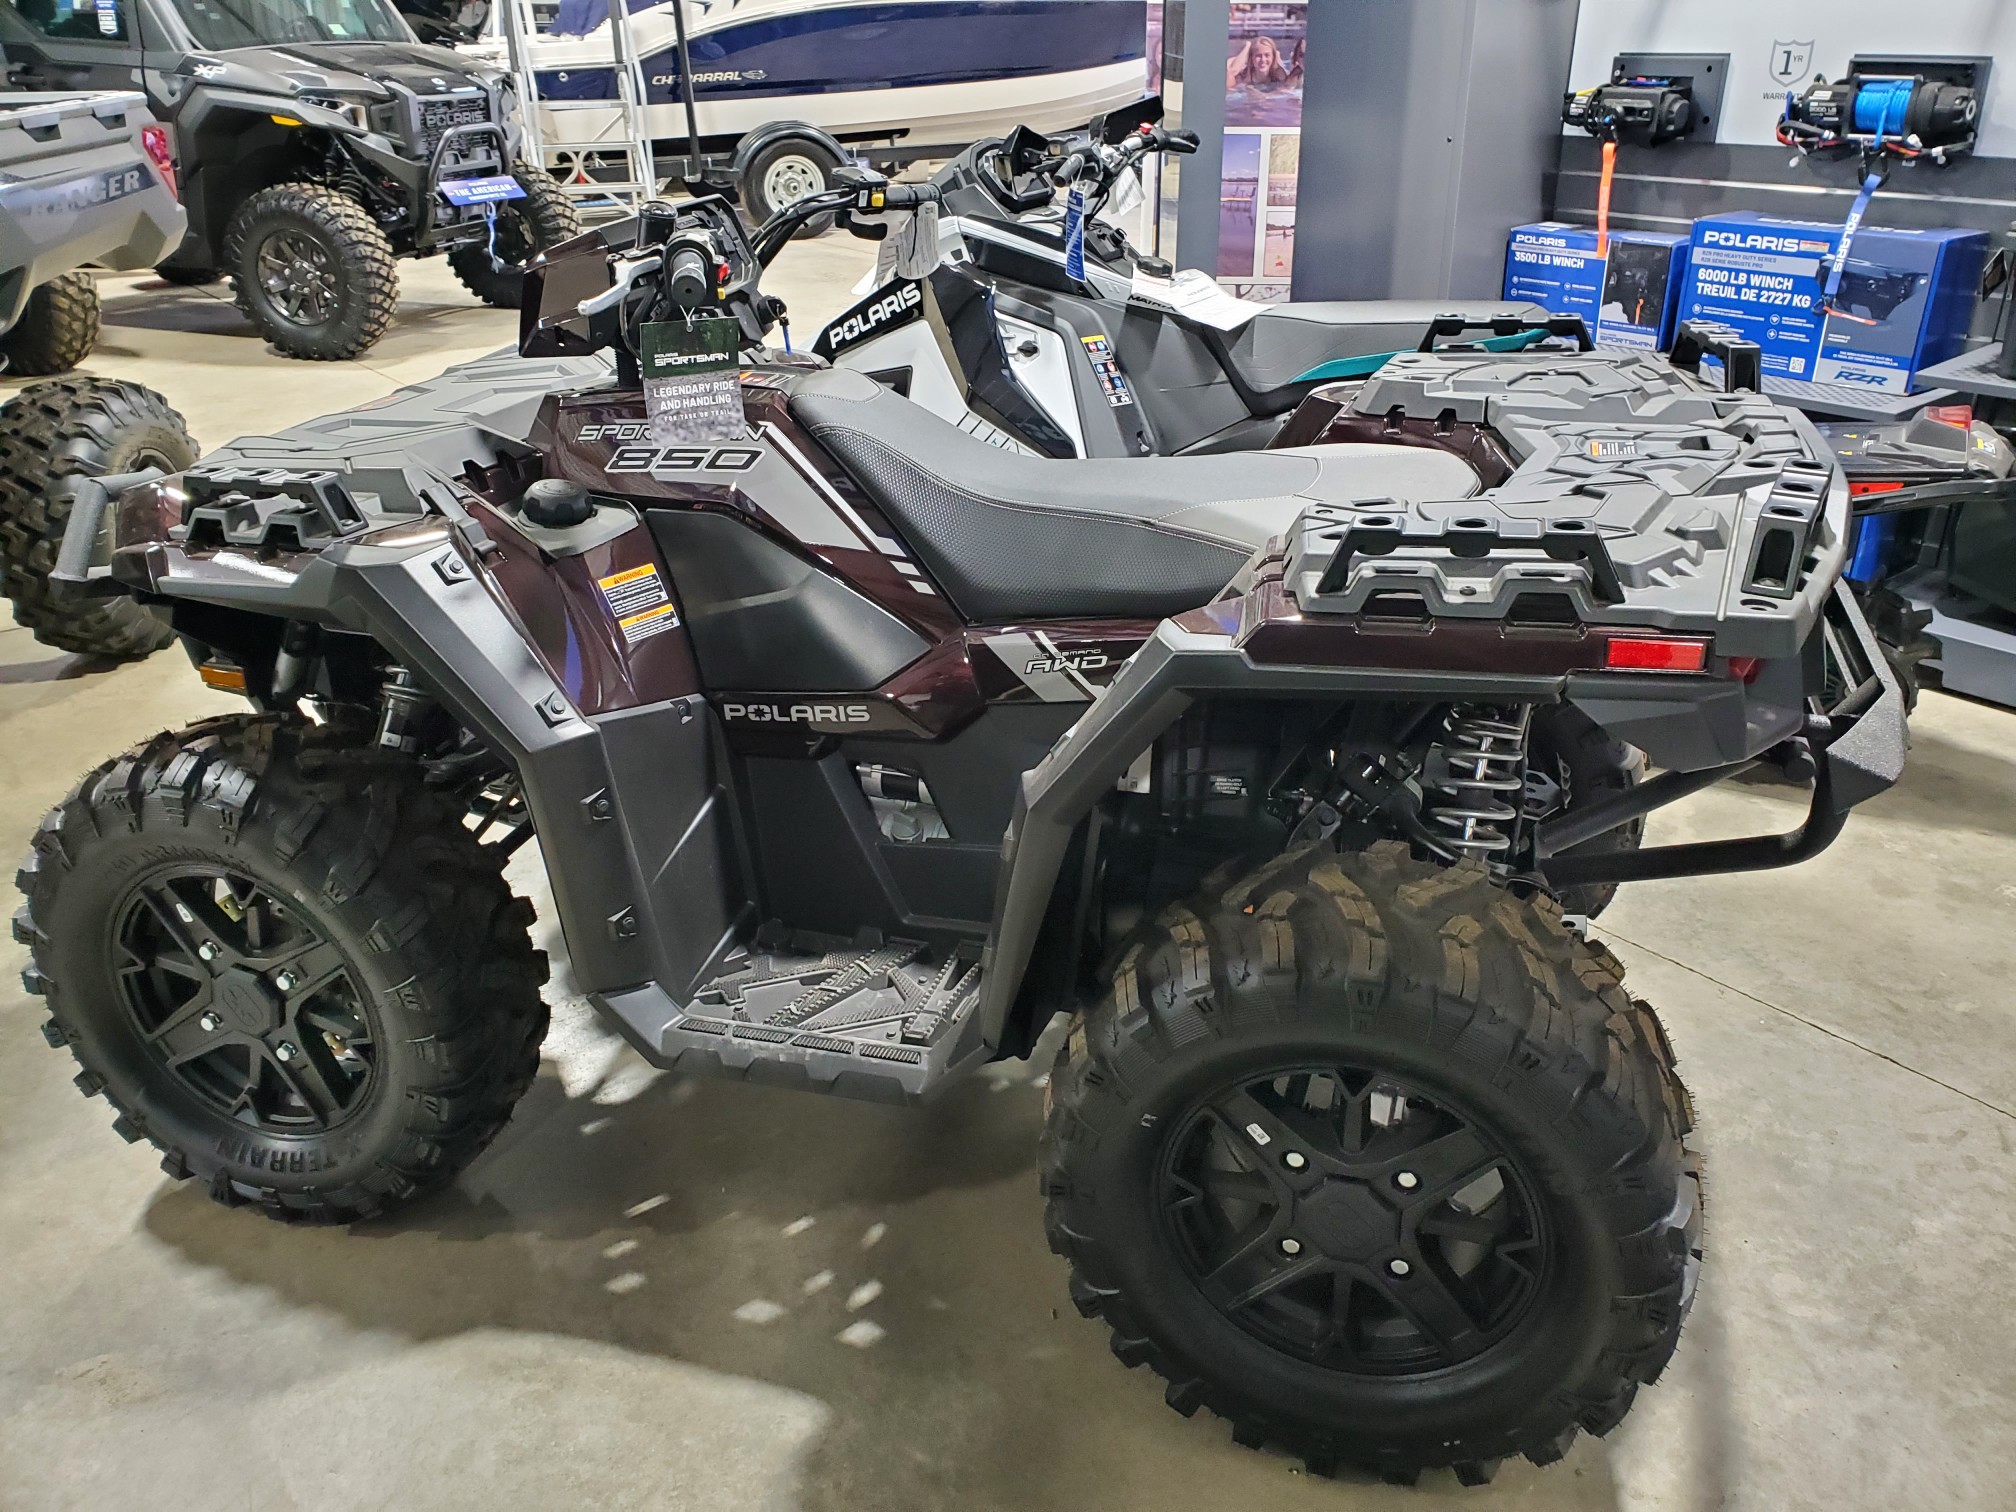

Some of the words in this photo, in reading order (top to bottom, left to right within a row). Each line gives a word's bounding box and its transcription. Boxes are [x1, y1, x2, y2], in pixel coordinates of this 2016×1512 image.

[193, 64, 227, 79] XP
[1778, 50, 1792, 76] 1
[1793, 54, 1804, 63] YR
[425, 110, 487, 128] POLARIS
[453, 188, 472, 196] THE
[472, 184, 512, 194] AMERICAN
[1516, 234, 1566, 248] POLARIS
[1704, 230, 1798, 252] POLARIS
[1833, 212, 1860, 273] POLARIS
[1514, 252, 1537, 262] 3500
[1538, 254, 1550, 264] LB
[1552, 256, 1584, 268] WINCH
[1724, 252, 1742, 260] HEAVY
[1758, 256, 1776, 264] SERIES
[1698, 268, 1728, 282] 6000
[1730, 272, 1747, 285] LB
[1750, 274, 1794, 290] WINCH
[1696, 282, 1738, 300] TREUIL
[1740, 288, 1758, 302] DE
[1759, 290, 1790, 306] 2727
[1792, 294, 1811, 308] KG
[829, 282, 921, 349] POLARIS
[1600, 336, 1652, 348] SPORTSMAN
[655, 352, 730, 366] SPORTSMAN
[1834, 370, 1888, 386] RZR
[654, 382, 711, 398] LEGENDARY
[713, 380, 736, 392] RIDE
[660, 399, 681, 411] AND
[682, 394, 732, 408] HANDLING
[700, 410, 708, 418] OR
[710, 408, 730, 416] TRAIL
[605, 446, 766, 472] 850
[620, 570, 644, 582] WARNING
[1024, 656, 1108, 674] AWD
[723, 704, 870, 722] POLARIS
